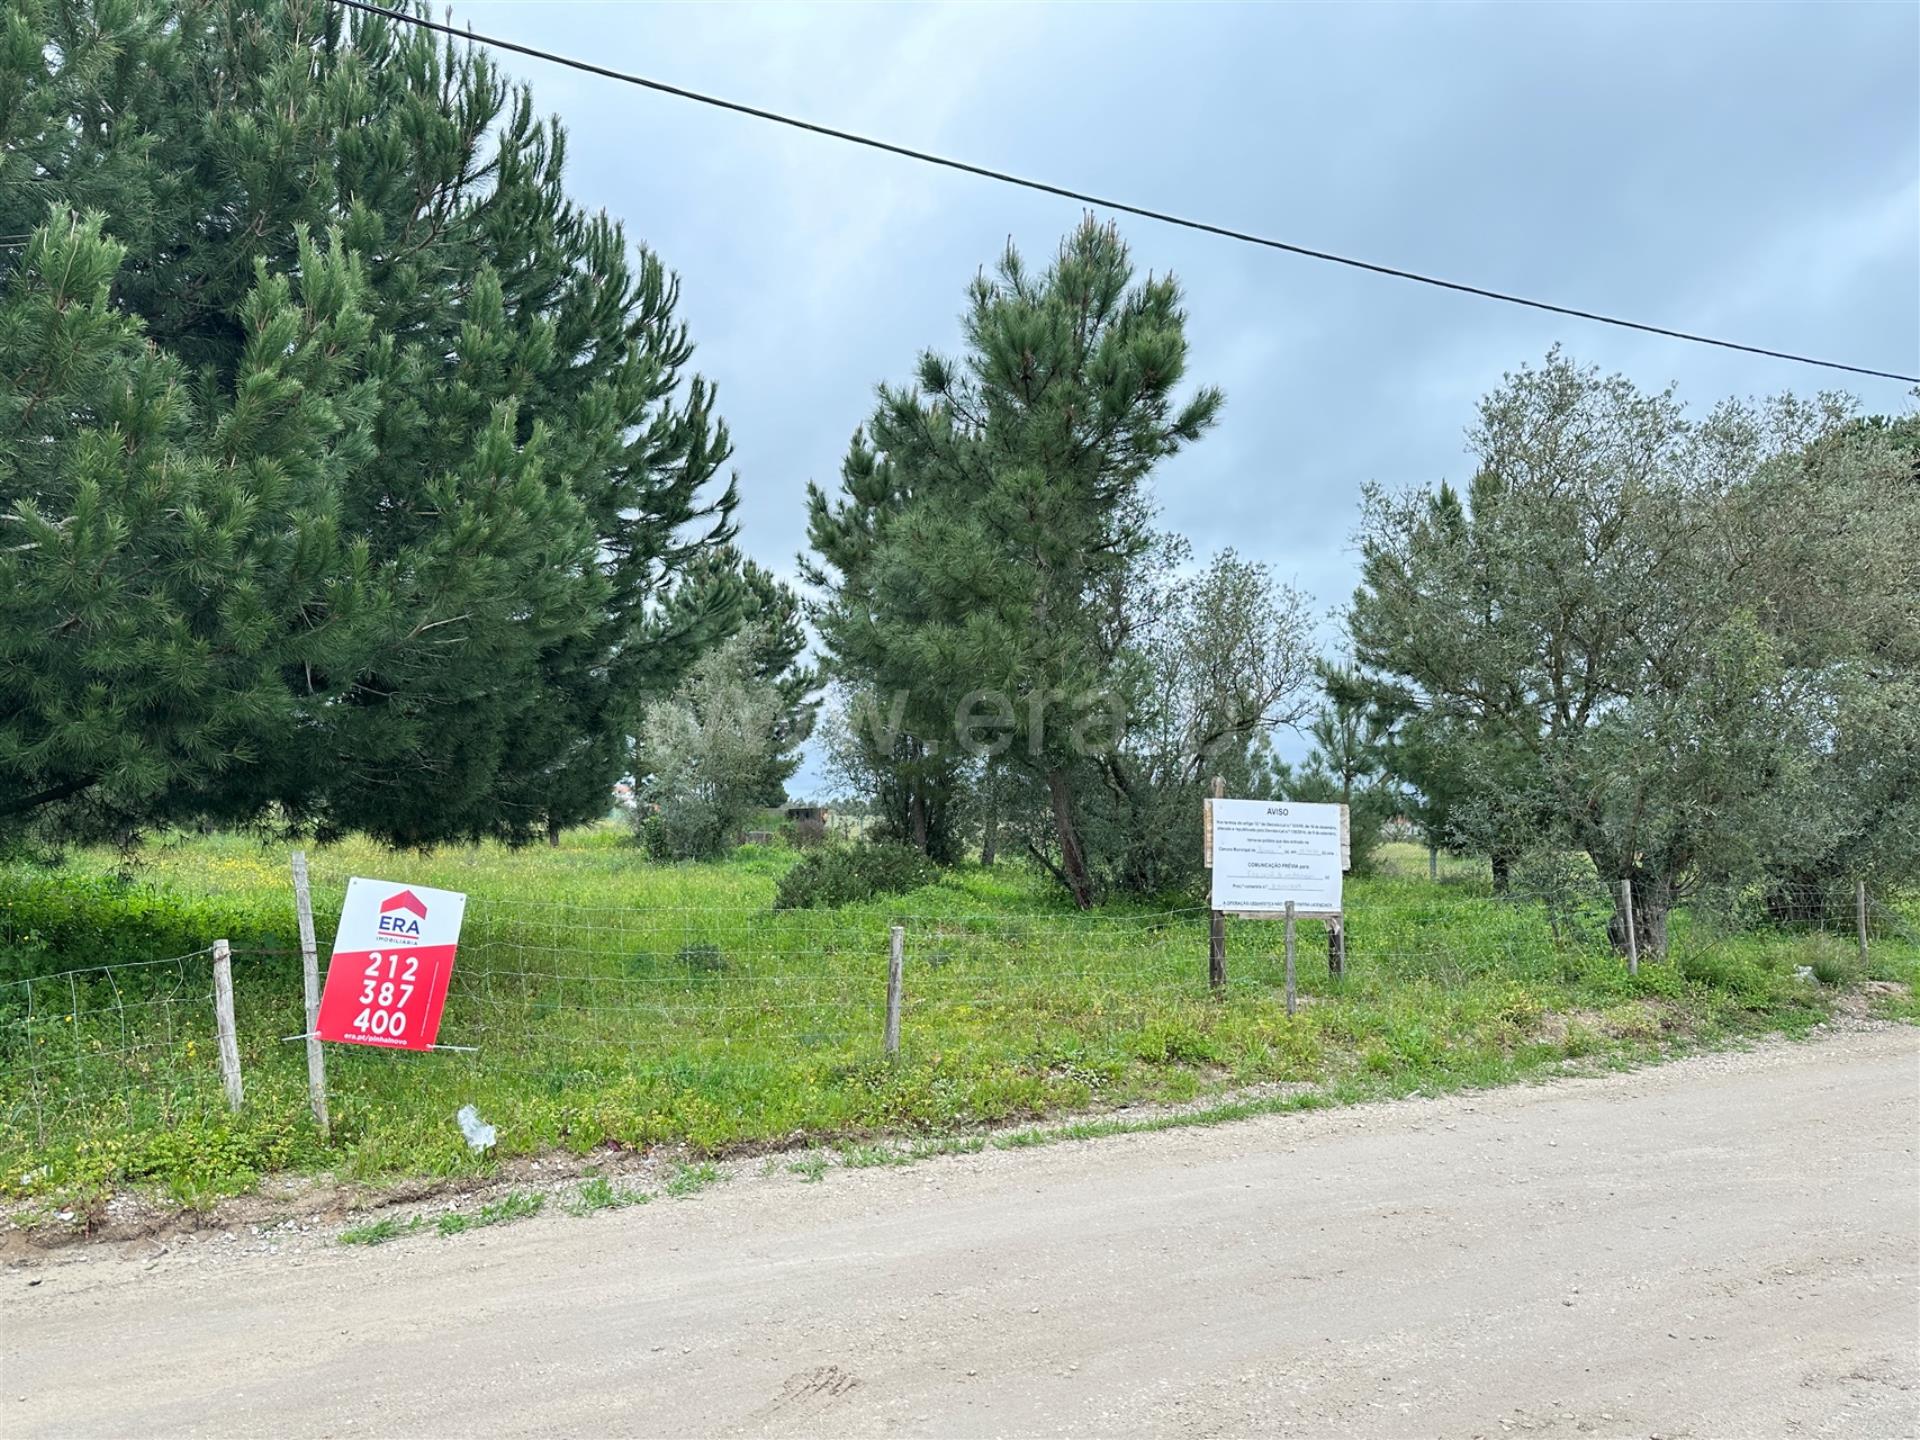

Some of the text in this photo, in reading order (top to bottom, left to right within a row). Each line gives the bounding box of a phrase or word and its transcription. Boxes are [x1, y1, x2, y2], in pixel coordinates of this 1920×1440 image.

[1267, 807, 1289, 817] AVISO
[379, 915, 420, 935] ERA
[364, 951, 419, 981] 212
[359, 978, 414, 1009] 387
[353, 1007, 407, 1037] 400
[343, 1033, 408, 1046] era.pt/pinhalnovo
